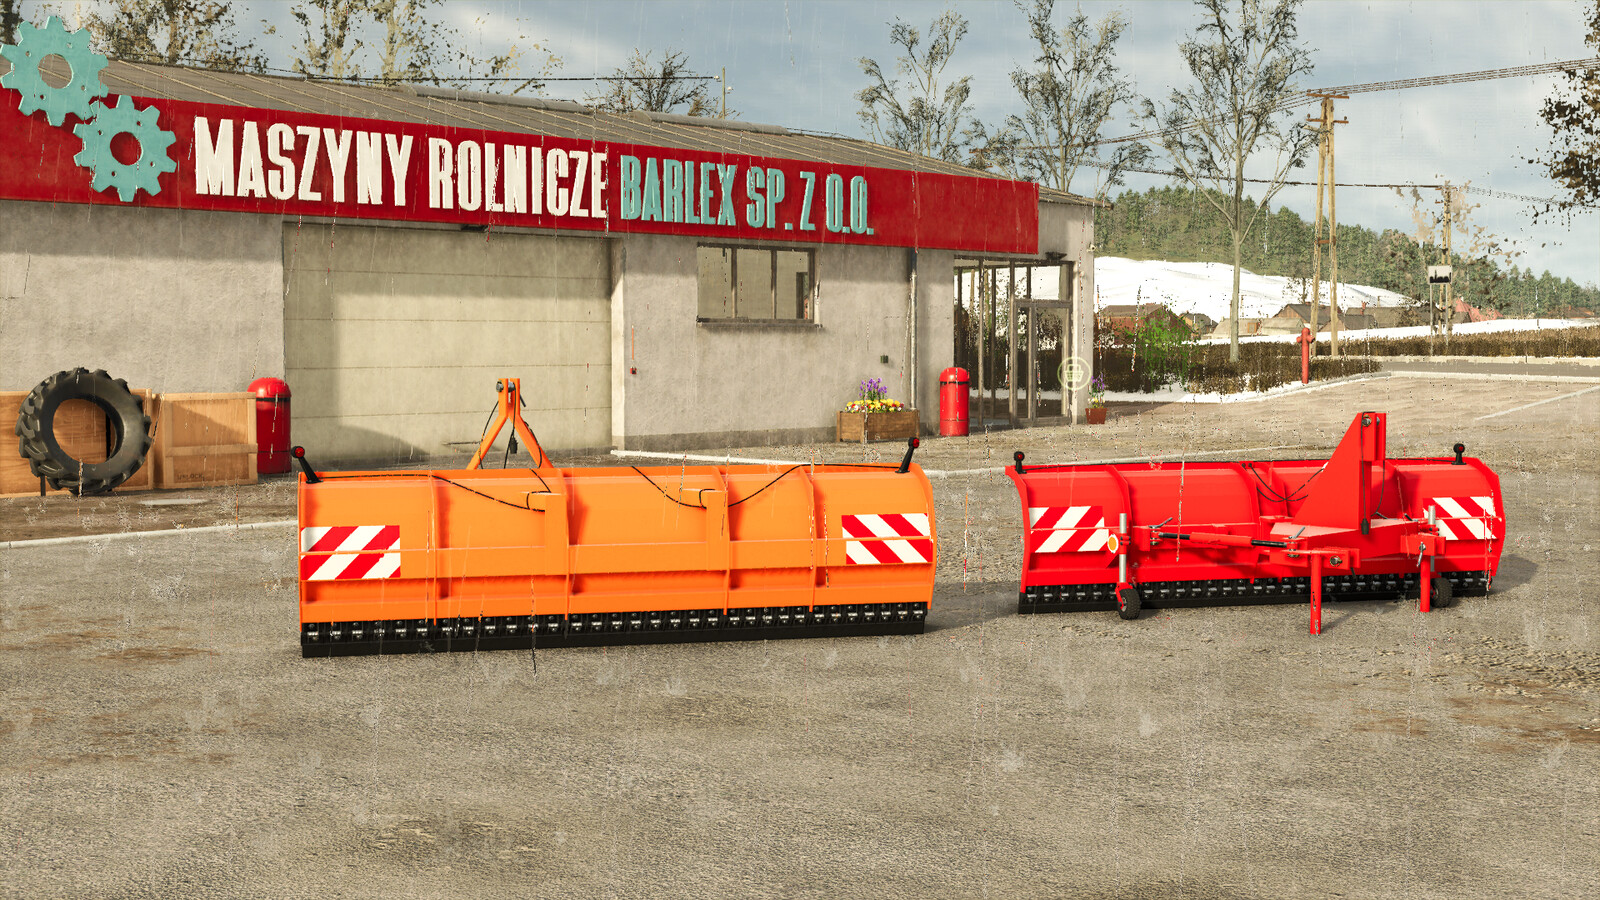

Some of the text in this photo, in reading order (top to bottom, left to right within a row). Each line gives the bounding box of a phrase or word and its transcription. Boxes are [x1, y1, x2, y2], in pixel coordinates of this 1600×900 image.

[194, 116, 874, 235] MASZYNY ROLNICZE BARLEX SP. Z O.O.
